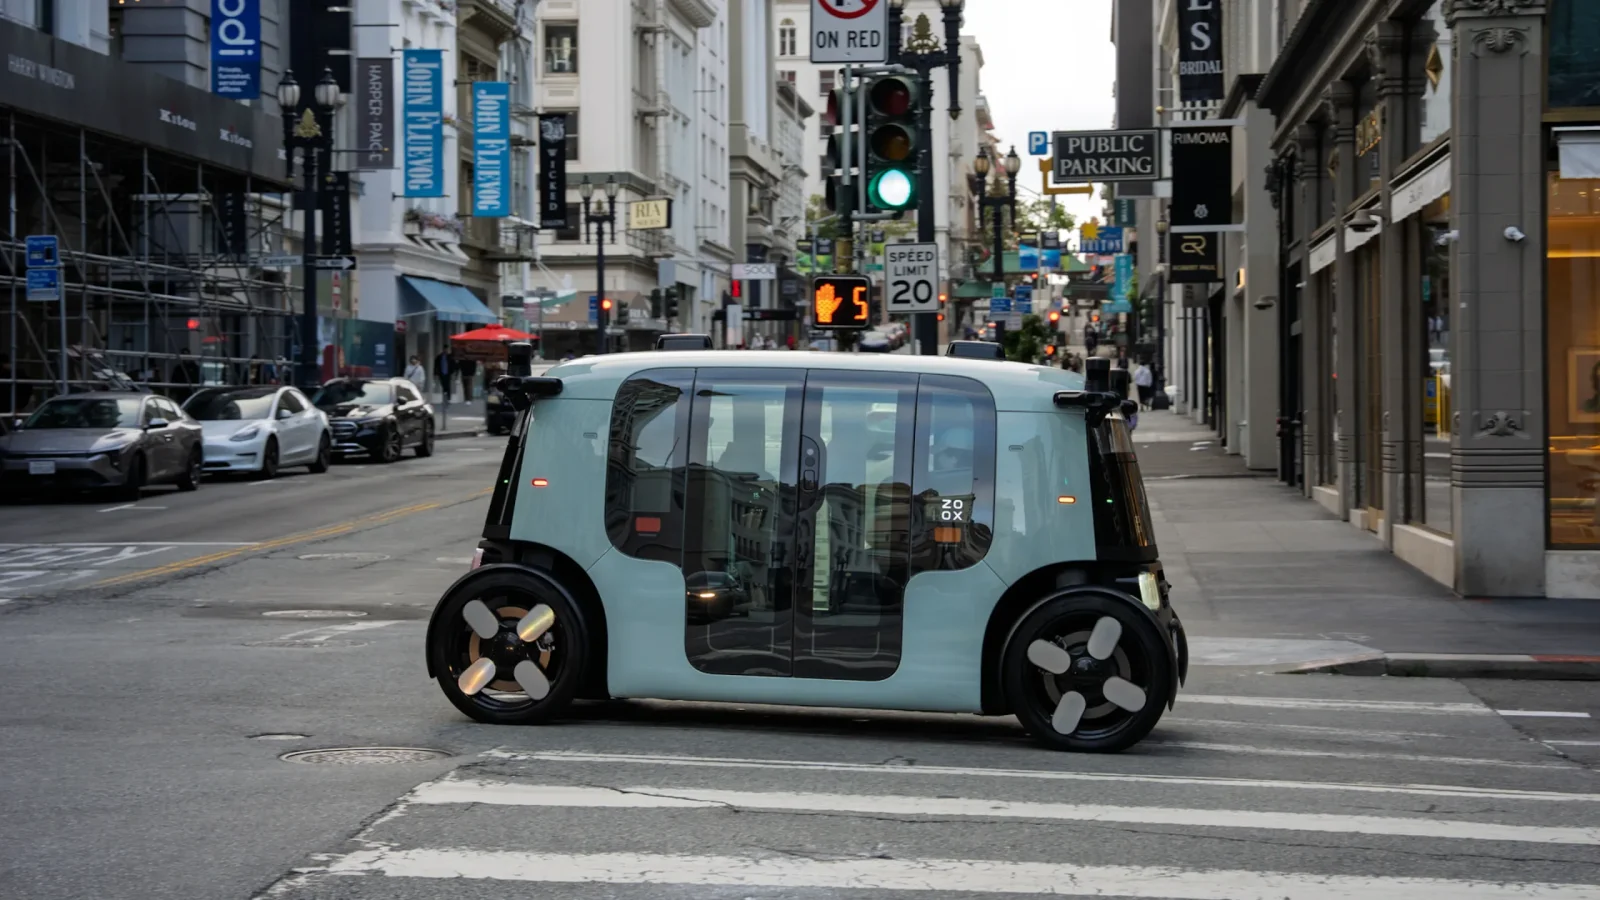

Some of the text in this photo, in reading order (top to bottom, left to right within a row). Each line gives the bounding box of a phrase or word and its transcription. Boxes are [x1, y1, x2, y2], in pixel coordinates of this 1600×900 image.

[816, 30, 881, 48] ON RED
[8, 53, 75, 90] HARRY WINSTON
[1180, 60, 1224, 75] BRIDAL
[368, 65, 383, 162] HARPER PAIGE
[406, 57, 441, 190] JOHN FLUEVOG
[1031, 133, 1045, 152] P
[1067, 135, 1144, 153] PUBLIC
[1173, 132, 1229, 144] RIMOWA
[477, 89, 508, 210] JOHN FLUEVOG
[1060, 156, 1152, 175] PARKING
[547, 148, 558, 211] WICKED
[889, 251, 934, 262] SPEED
[894, 265, 929, 276] LIMIT
[892, 280, 932, 304] 20
[852, 286, 868, 320] 5
